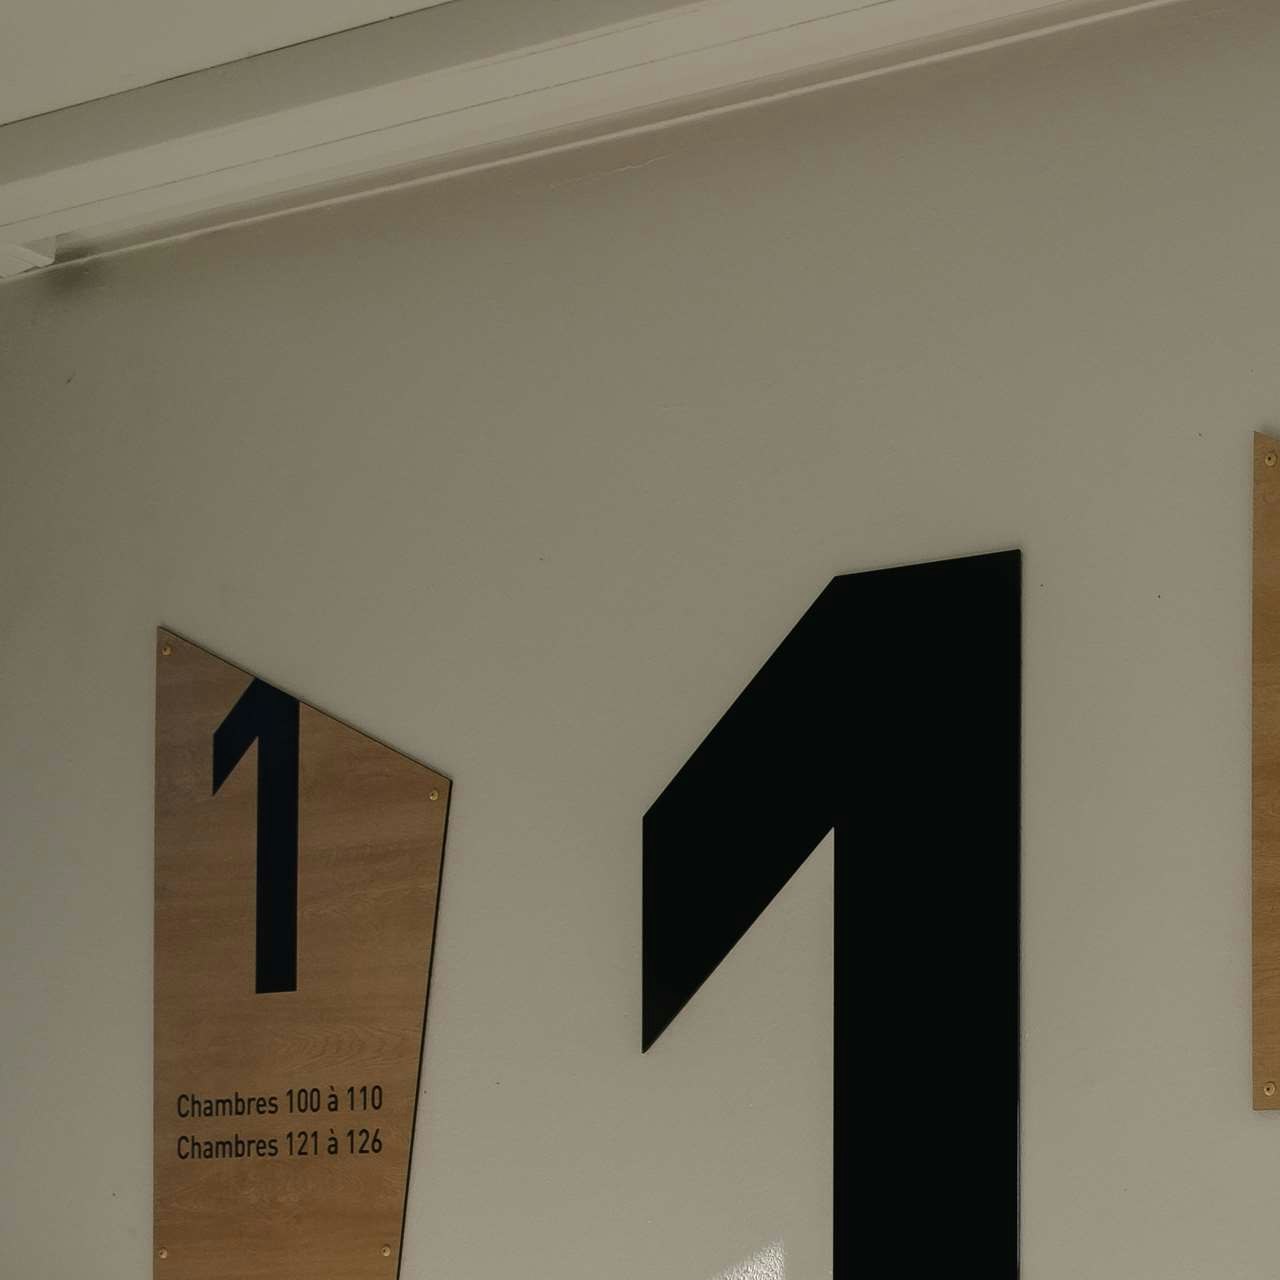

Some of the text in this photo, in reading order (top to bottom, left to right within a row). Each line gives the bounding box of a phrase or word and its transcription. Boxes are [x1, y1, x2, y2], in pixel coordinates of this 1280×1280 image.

[212, 676, 300, 995] 1
[177, 1085, 383, 1118] Chambres 100 à 110
[177, 1128, 383, 1160] Chambres 121 à 126
